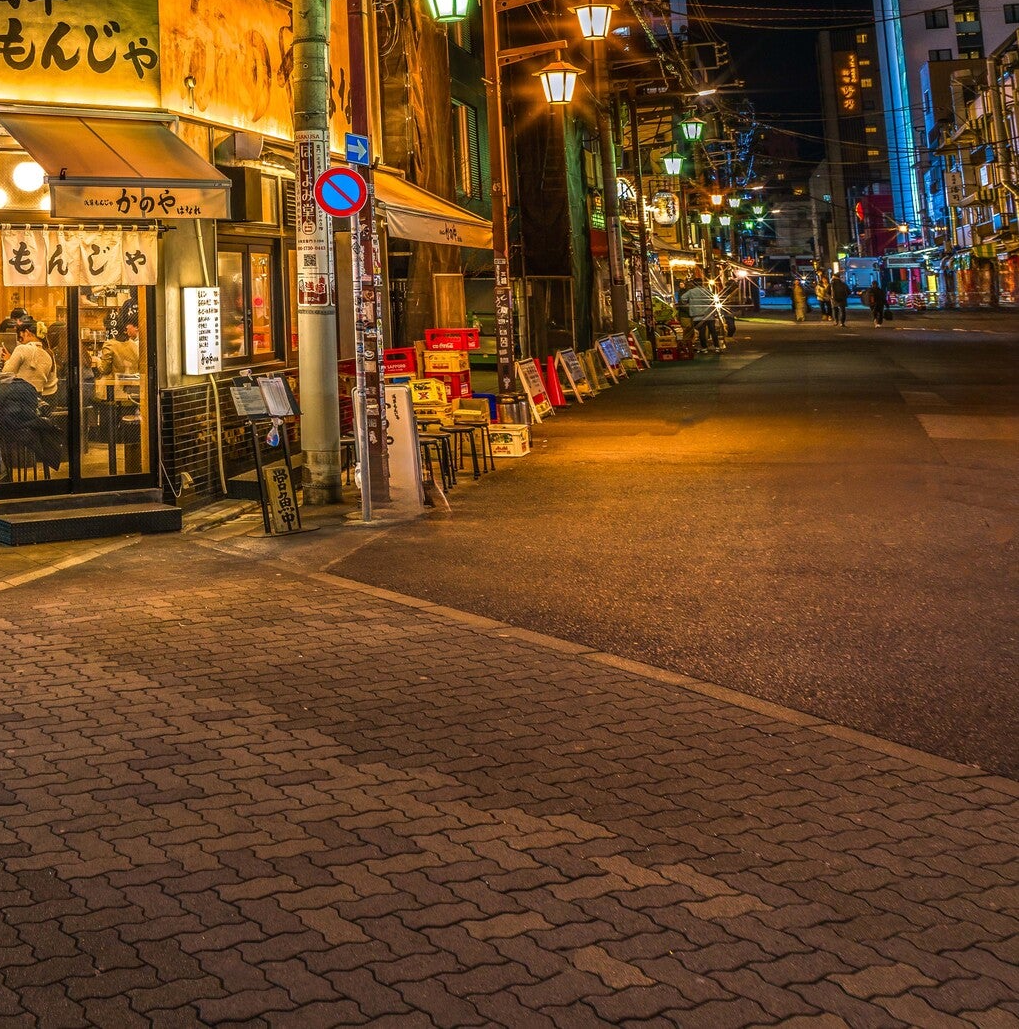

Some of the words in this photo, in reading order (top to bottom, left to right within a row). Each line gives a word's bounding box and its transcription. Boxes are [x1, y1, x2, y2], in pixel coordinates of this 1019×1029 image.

[116, 188, 176, 214] かのや
[176, 205, 202, 215] はなれ
[9, 241, 147, 276] もんじゃ
[110, 309, 119, 338] かのや
[273, 468, 296, 532] 営魚中
